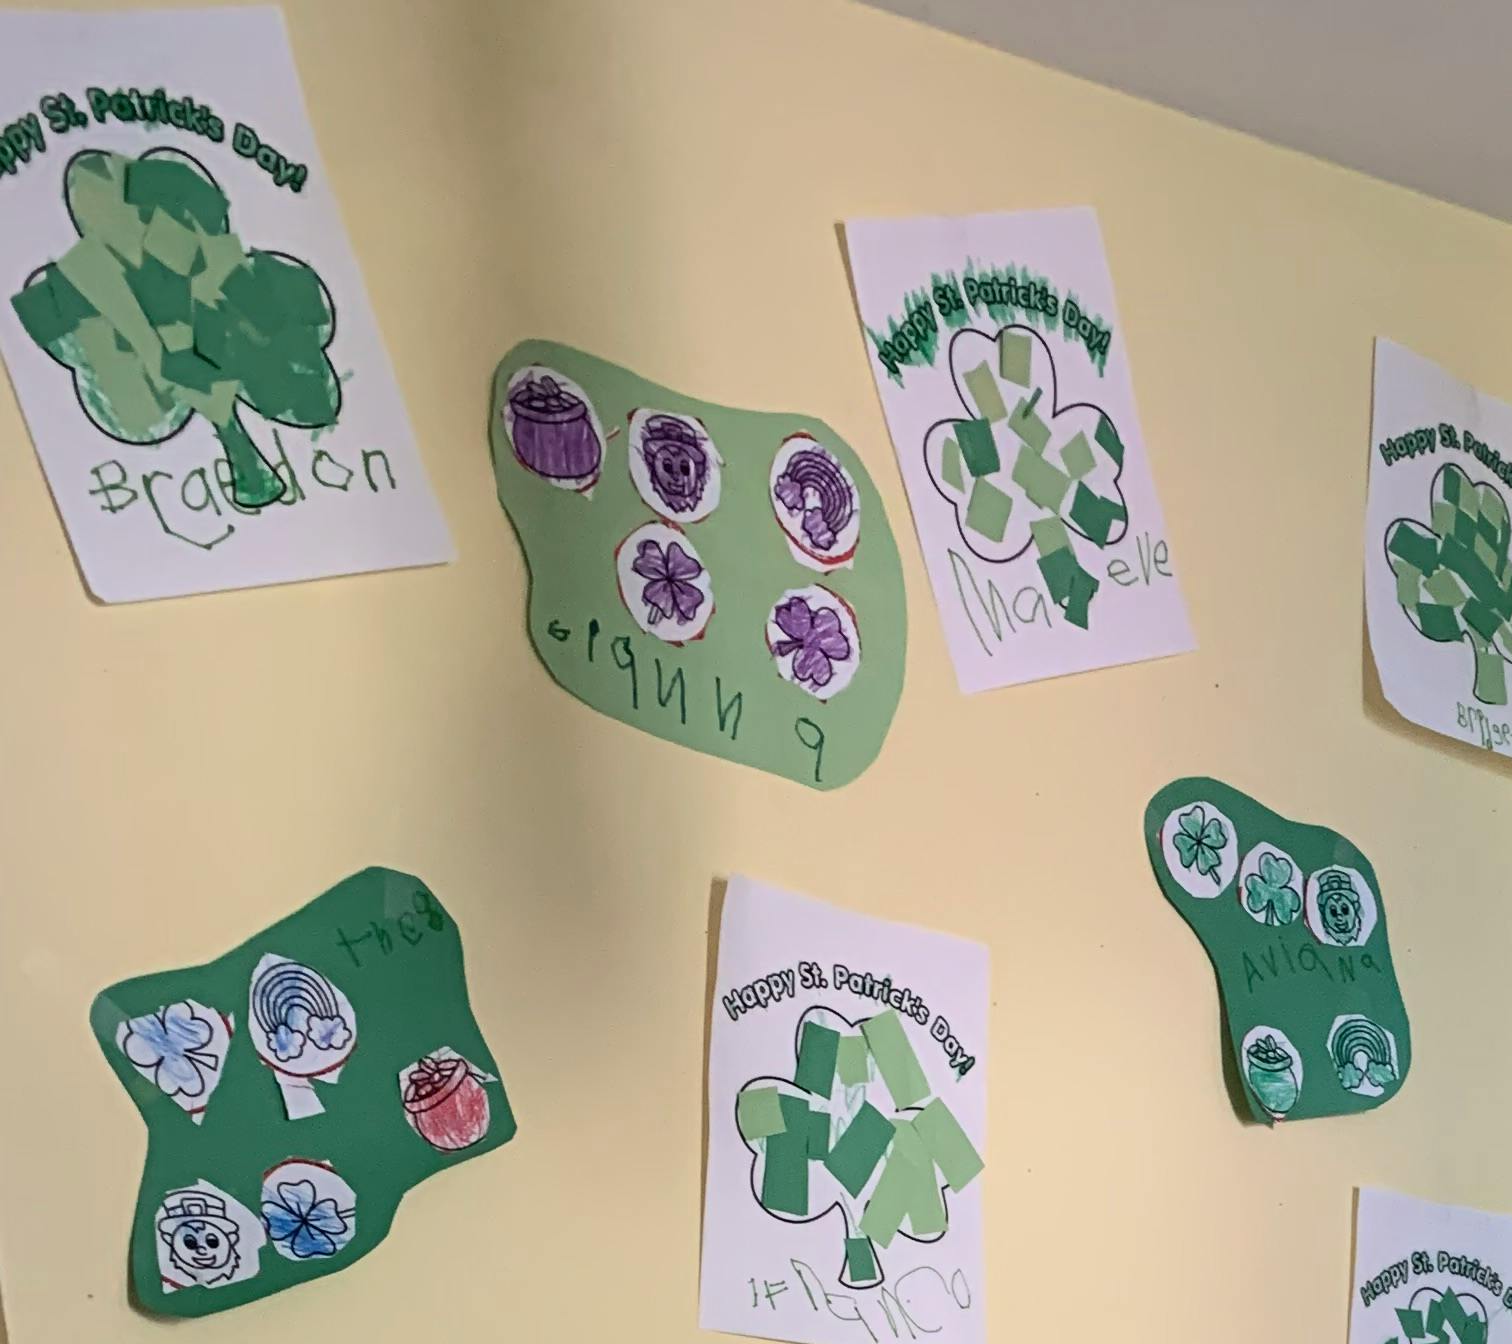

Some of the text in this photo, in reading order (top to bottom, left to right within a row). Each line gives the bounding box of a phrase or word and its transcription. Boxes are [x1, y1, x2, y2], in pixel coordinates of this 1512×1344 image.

[40, 92, 88, 133] St.
[86, 87, 224, 143] Patrick's
[232, 122, 308, 193] Day!
[878, 276, 1111, 374] Happy St. Patrick's Day!
[1380, 425, 1436, 466] Happy
[1438, 422, 1461, 450] St.
[722, 960, 976, 1075] Happy St. Patrick's Day!
[1360, 1257, 1409, 1307] Happy
[1410, 1251, 1434, 1276] St.
[1437, 1250, 1503, 1297] Patrick's
